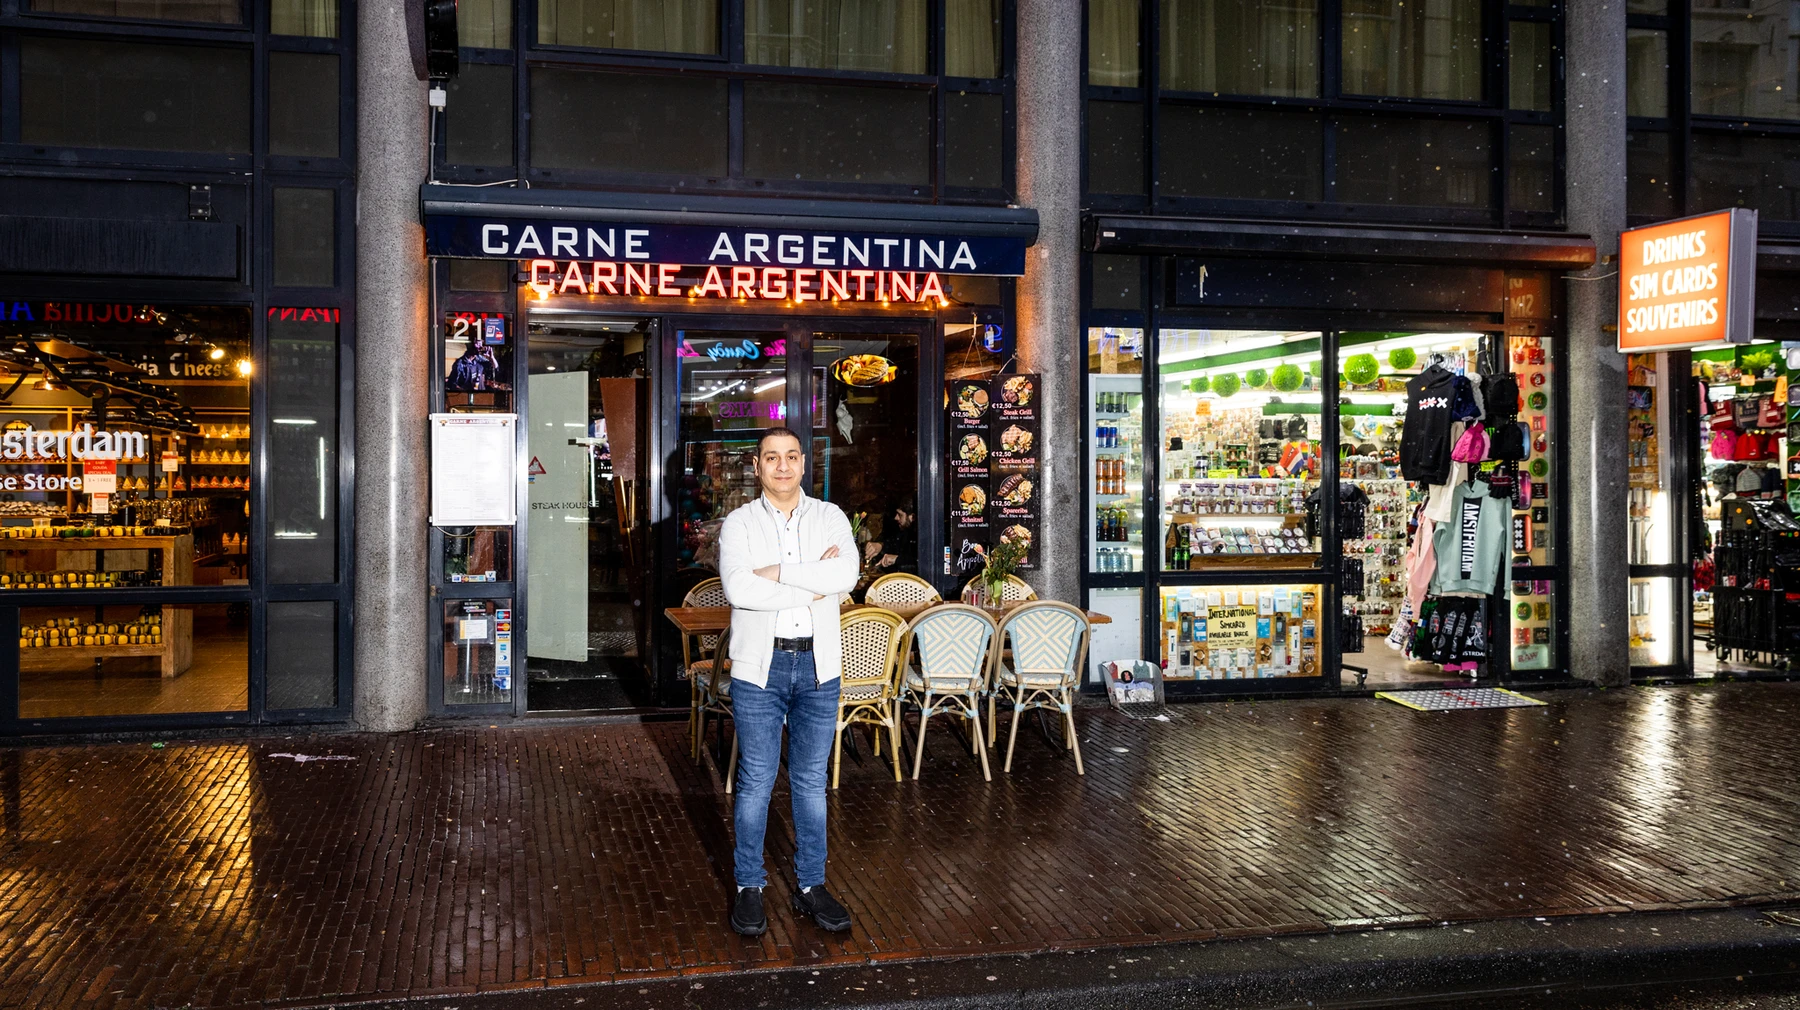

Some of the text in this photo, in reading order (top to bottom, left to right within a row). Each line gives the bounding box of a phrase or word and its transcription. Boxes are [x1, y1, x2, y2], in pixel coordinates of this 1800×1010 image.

[481, 223, 977, 270] CARNE ARGENTINA
[1643, 230, 1706, 266] DRINKS
[529, 258, 946, 303] CARNE ARGENTINA
[1629, 263, 1718, 301] SIM CARDS
[453, 318, 482, 341] 21
[1627, 298, 1718, 334] SOUVENIRS
[0, 423, 145, 460] sterdam
[24, 473, 82, 490] Store
[1208, 609, 1256, 619] INTERNATIONAL
